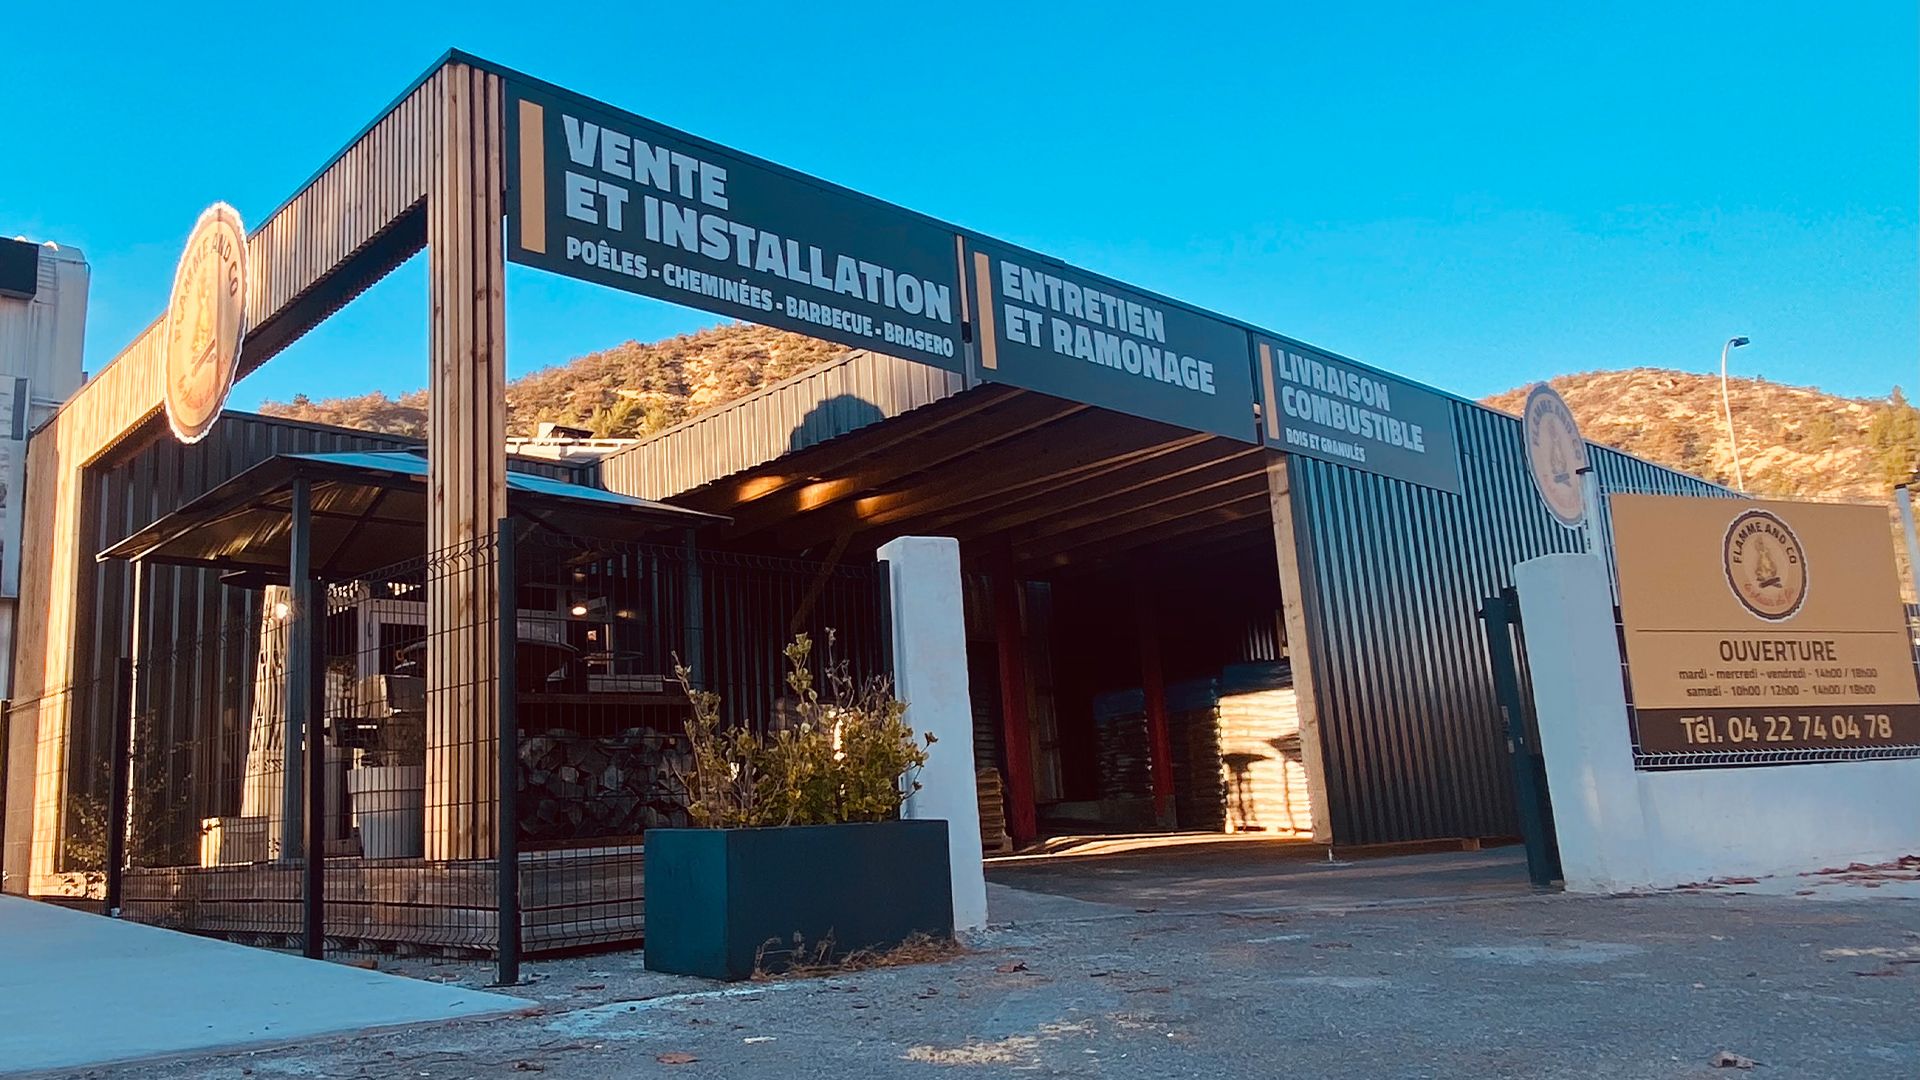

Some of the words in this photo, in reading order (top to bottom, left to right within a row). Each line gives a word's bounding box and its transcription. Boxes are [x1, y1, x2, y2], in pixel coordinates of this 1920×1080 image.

[561, 114, 729, 210] VENTE
[211, 232, 232, 263] AND
[228, 261, 239, 298] CO
[565, 170, 629, 232] ET
[643, 194, 953, 324] INSTALLATION
[566, 236, 648, 280] POÊLES
[662, 261, 773, 312] CHEMINÉES
[786, 295, 873, 338] BARBECUE
[884, 320, 955, 358] BRASERO
[1000, 260, 1166, 343] ENTRETIEN
[1003, 303, 1044, 348] ET
[1051, 316, 1216, 395] RAMONAGE
[1276, 348, 1391, 412] LIVRAISON
[1281, 385, 1425, 453] COMBUSTIBLE
[1285, 427, 1308, 448] BOIS
[1309, 433, 1320, 451] ET
[1320, 437, 1366, 463] GRANULÉS
[1733, 522, 1763, 564] FLAMME
[1764, 524, 1787, 545] AND
[1786, 547, 1797, 564] CO
[1679, 669, 1707, 680] mardi
[1716, 668, 1758, 679] mercredi
[1766, 668, 1806, 679] vendredi
[1815, 668, 1842, 678] 14h00
[1719, 640, 1837, 662] OUVERTURE
[1686, 686, 1722, 697] samedi
[1731, 685, 1761, 696] 10h00
[1770, 685, 1799, 696] 12h00
[1679, 716, 1723, 744] Tél.
[1728, 716, 1759, 742] 04
[1763, 715, 1794, 741] 22
[1798, 715, 1828, 740] 74
[1831, 714, 1861, 740] 04
[1864, 714, 1893, 738] 78
